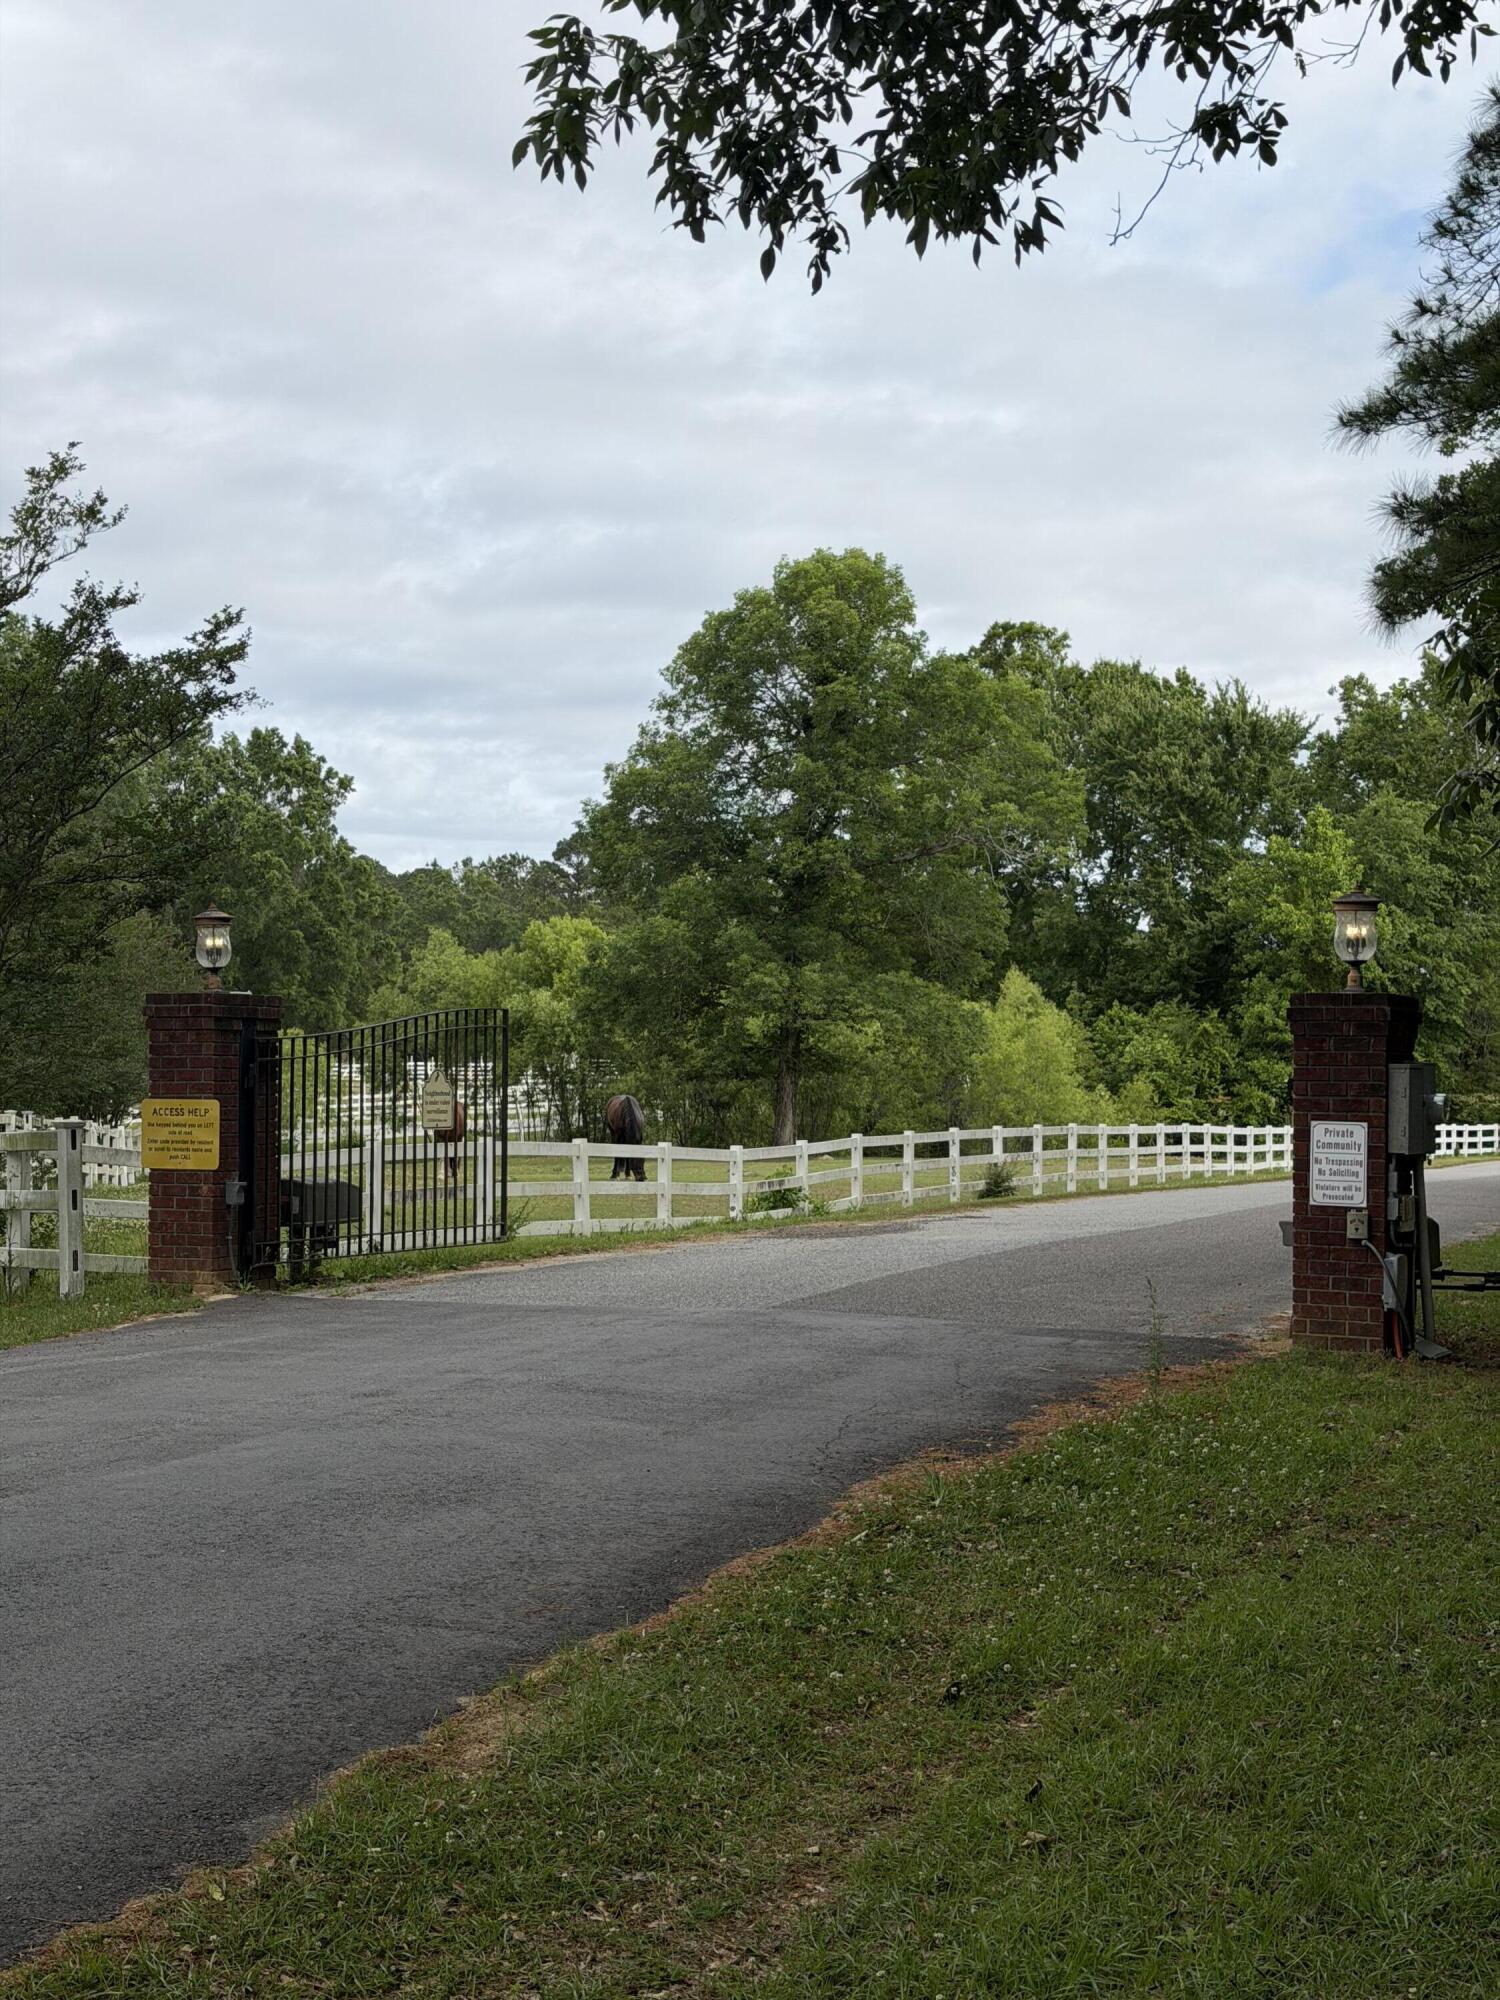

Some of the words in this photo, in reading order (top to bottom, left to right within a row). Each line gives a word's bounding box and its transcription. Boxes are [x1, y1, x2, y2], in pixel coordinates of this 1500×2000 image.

[152, 1107, 184, 1116] ACCESS
[188, 1108, 210, 1117] HELP
[1324, 1128, 1354, 1138] Private
[1316, 1139, 1362, 1152] Community
[1314, 1157, 1322, 1165] No
[1326, 1157, 1363, 1168] Trespassing
[1318, 1168, 1326, 1176] No
[1329, 1168, 1360, 1179] Soliciting
